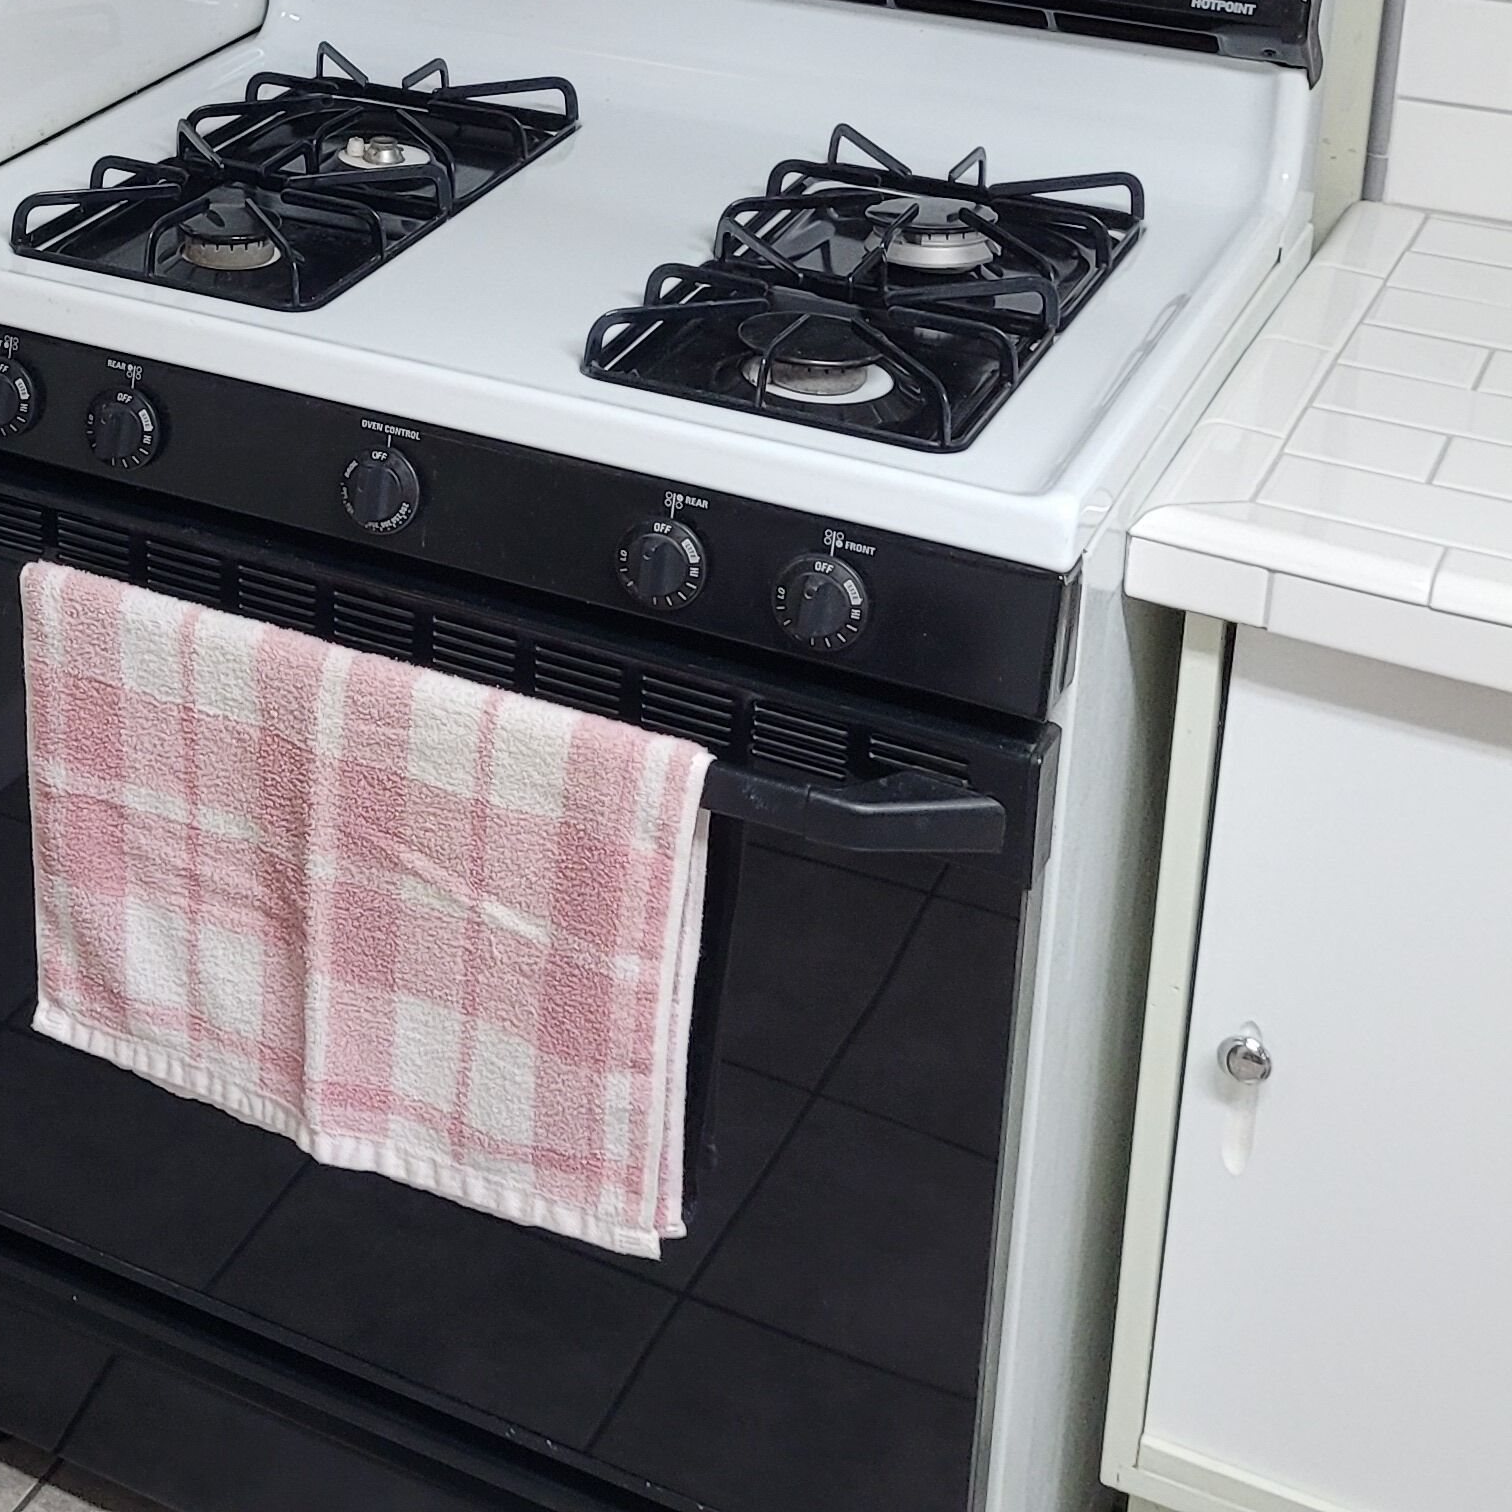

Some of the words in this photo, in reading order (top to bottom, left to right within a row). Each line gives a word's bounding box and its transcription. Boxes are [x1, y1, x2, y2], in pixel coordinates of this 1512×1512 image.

[107, 359, 126, 371] REAR
[117, 392, 133, 403] OFF
[361, 419, 383, 431] OVEN
[384, 424, 421, 441] CONTROL
[371, 450, 388, 461] OFF
[685, 496, 709, 509] REAR
[653, 522, 672, 534] OFF
[844, 540, 876, 556] FRONT
[619, 549, 627, 562] LO
[689, 567, 699, 578] HI
[814, 561, 834, 574] OFF
[776, 587, 786, 600] LO
[850, 608, 861, 620] HI
